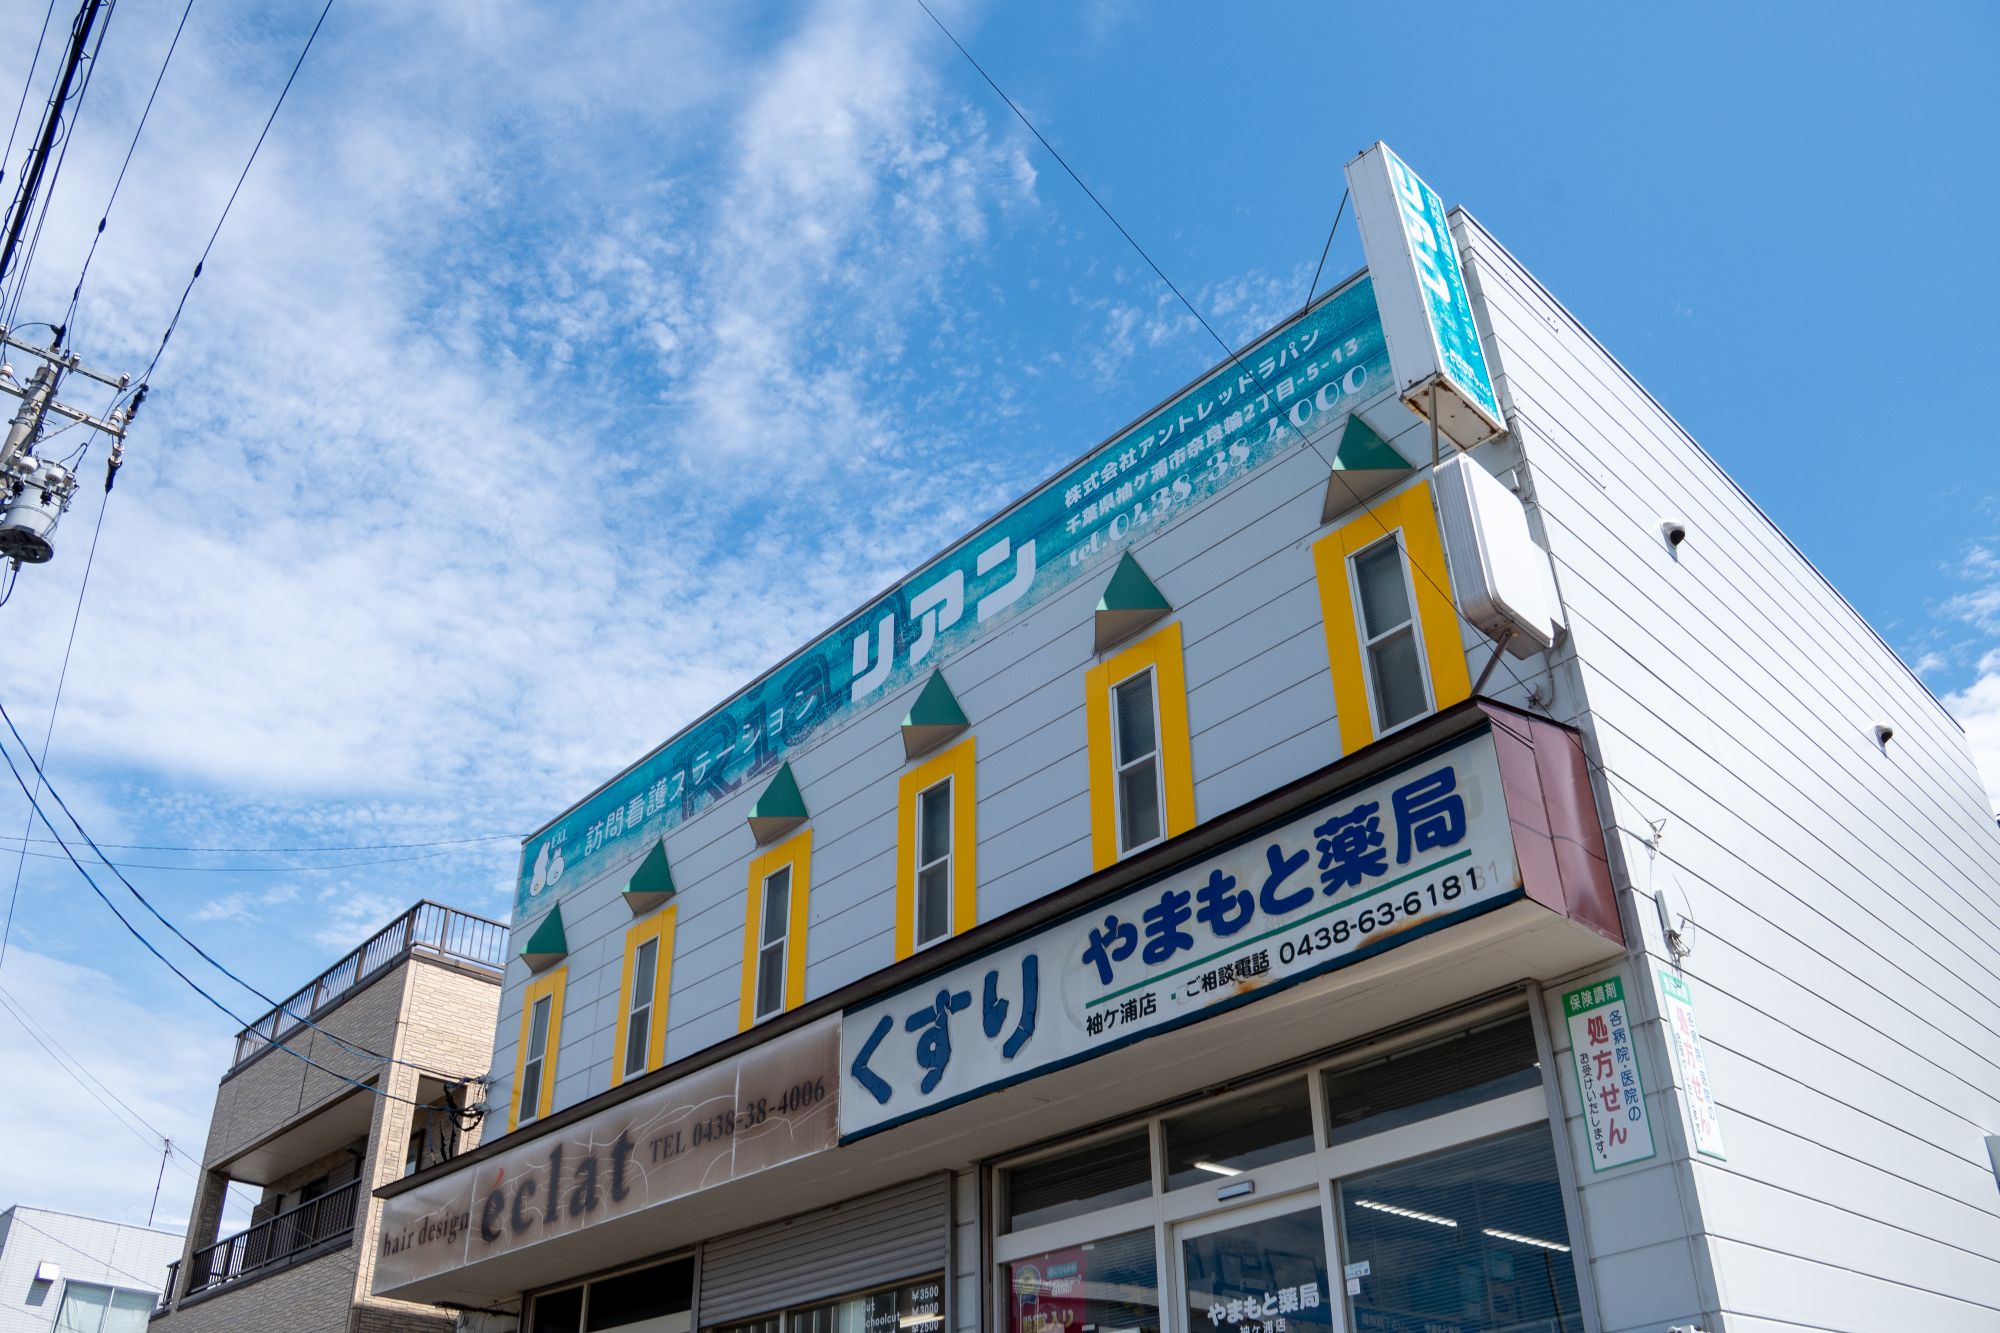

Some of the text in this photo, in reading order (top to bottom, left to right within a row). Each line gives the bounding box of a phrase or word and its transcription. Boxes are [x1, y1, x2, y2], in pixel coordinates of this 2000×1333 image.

[1064, 328, 1319, 508] 株式会社アントレッドラパン
[851, 536, 1036, 704] リアン
[584, 689, 817, 857] 訪問看護ステーション
[1082, 766, 1466, 985] やまもと薬局
[1186, 949, 1270, 997] ご相談電話
[1279, 867, 1478, 964] 0438-63-6181
[851, 954, 1038, 1105] くすり
[1587, 1015, 1627, 1147] 処方せん
[650, 1075, 825, 1163] TEL 0438-38-4006
[382, 1211, 470, 1257] hair design
[481, 1128, 635, 1243] éclat
[1207, 1282, 1320, 1326] やまもと薬局
